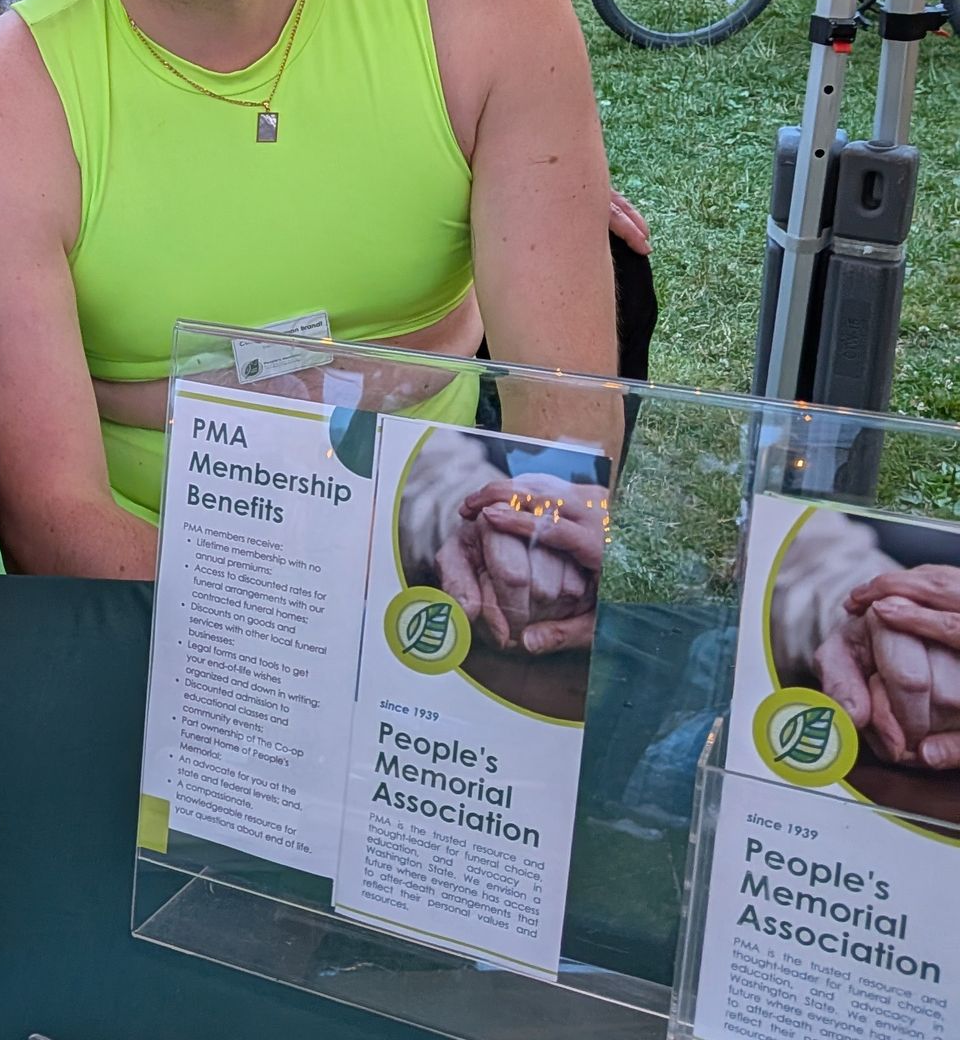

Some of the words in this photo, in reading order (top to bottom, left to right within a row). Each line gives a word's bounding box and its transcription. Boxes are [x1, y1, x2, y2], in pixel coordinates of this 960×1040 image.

[193, 417, 248, 448] PMA
[188, 450, 351, 506] Membership
[187, 483, 284, 523] Benefits
[183, 521, 203, 534] PMA
[204, 528, 245, 543] members
[195, 552, 226, 565] annual
[196, 537, 230, 553] Lifetime
[230, 546, 287, 566] membership
[287, 559, 307, 569] with
[308, 563, 321, 573] no
[193, 563, 225, 578] Access
[226, 570, 236, 581] to
[237, 573, 288, 592] discounted
[289, 586, 312, 598] rates
[313, 590, 327, 600] for
[193, 575, 223, 591] funeral
[224, 585, 287, 606] arrangements
[287, 599, 307, 610] with
[308, 604, 325, 613] our
[190, 601, 231, 619] Discounts
[232, 613, 246, 622] on
[246, 616, 275, 629] goods
[276, 623, 296, 634] and
[191, 590, 242, 608] contracted
[242, 600, 275, 616] funeral
[189, 616, 223, 630] services
[224, 623, 244, 635] with
[244, 628, 270, 640] other
[270, 633, 293, 647] local
[294, 639, 327, 655] funeral
[186, 654, 206, 665] your
[206, 659, 252, 676] end-of-life
[252, 670, 281, 684] wishes
[187, 639, 212, 653] Legal
[213, 645, 237, 660] forms
[238, 654, 257, 665] and
[258, 657, 279, 671] tools
[281, 663, 291, 673] to
[292, 668, 309, 677] get
[184, 677, 234, 698] Discounted
[234, 692, 278, 711] admission
[280, 703, 290, 713] to
[185, 666, 229, 684] organized
[230, 678, 250, 689] and
[250, 682, 276, 696] down
[277, 688, 286, 699] in
[182, 704, 231, 725] community
[183, 692, 237, 712] educational
[237, 705, 269, 721] classes
[269, 715, 289, 726] and
[379, 699, 410, 714] since
[414, 706, 439, 721] 1939
[180, 728, 212, 745] Funeral
[213, 737, 240, 752] Home
[241, 746, 252, 755] of
[252, 748, 289, 767] People's
[181, 715, 199, 728] Part
[200, 722, 244, 742] ownership
[245, 734, 256, 743] of
[256, 736, 272, 749] The
[274, 742, 304, 757] Co-op
[378, 721, 498, 773] People's
[176, 779, 184, 789] A
[177, 767, 199, 780] state
[200, 774, 219, 785] and
[220, 777, 252, 795] federal
[178, 754, 191, 765] An
[192, 759, 236, 778] advocate
[237, 770, 250, 781] for
[250, 776, 268, 787] you
[269, 782, 279, 791] at
[281, 783, 296, 796] the
[374, 751, 512, 809] Memorial
[174, 805, 194, 816] your
[194, 811, 235, 830] questions
[236, 824, 264, 839] about
[264, 833, 284, 845] end
[284, 839, 295, 848] of
[296, 841, 312, 854] life.
[175, 790, 243, 819] knowledgeable
[244, 813, 282, 832] resource
[284, 824, 297, 835] for
[371, 781, 539, 848] Association
[746, 813, 782, 831] since
[787, 823, 818, 840] 1939
[368, 823, 442, 852] thought-leader
[445, 845, 460, 857] for
[464, 850, 500, 869] funeral
[369, 812, 391, 827] PMA
[396, 819, 404, 830] is
[410, 824, 427, 836] the
[432, 830, 467, 848] trusted
[472, 843, 517, 862] resource
[522, 858, 545, 870] and
[365, 855, 393, 872] future
[396, 867, 427, 882] where
[430, 877, 478, 897] everyone
[481, 889, 500, 904] has
[503, 899, 540, 916] access
[366, 844, 423, 869] Washington
[427, 863, 456, 880] State.
[463, 873, 480, 886] We
[485, 882, 527, 900] envision
[532, 896, 541, 904] a
[432, 855, 453, 867] and
[465, 864, 520, 888] advocacy
[532, 882, 542, 893] in
[745, 837, 890, 900] People's
[361, 890, 409, 911] resources.
[362, 879, 394, 894] reflect
[400, 888, 422, 902] their
[427, 898, 471, 918] personal
[477, 913, 509, 930] values
[515, 926, 538, 938] and
[364, 866, 374, 877] to
[379, 873, 435, 896] after-death
[440, 891, 511, 919] arrangements
[517, 913, 539, 927] that
[740, 870, 907, 940] Memorial
[736, 903, 940, 984] Association
[732, 949, 820, 984] thought-leader
[825, 977, 842, 990] for
[848, 984, 891, 1005] funeral
[733, 936, 760, 953] PMA
[767, 950, 775, 958] is
[782, 952, 802, 966] the
[810, 961, 851, 981] trusted
[858, 976, 912, 998] resource
[920, 994, 947, 1008] and
[729, 973, 797, 1002] Washington
[847, 1009, 867, 1023] We
[874, 1019, 925, 1039] envision
[809, 987, 835, 1001] and
[850, 1000, 916, 1026] advocacy
[932, 1023, 944, 1031] in
